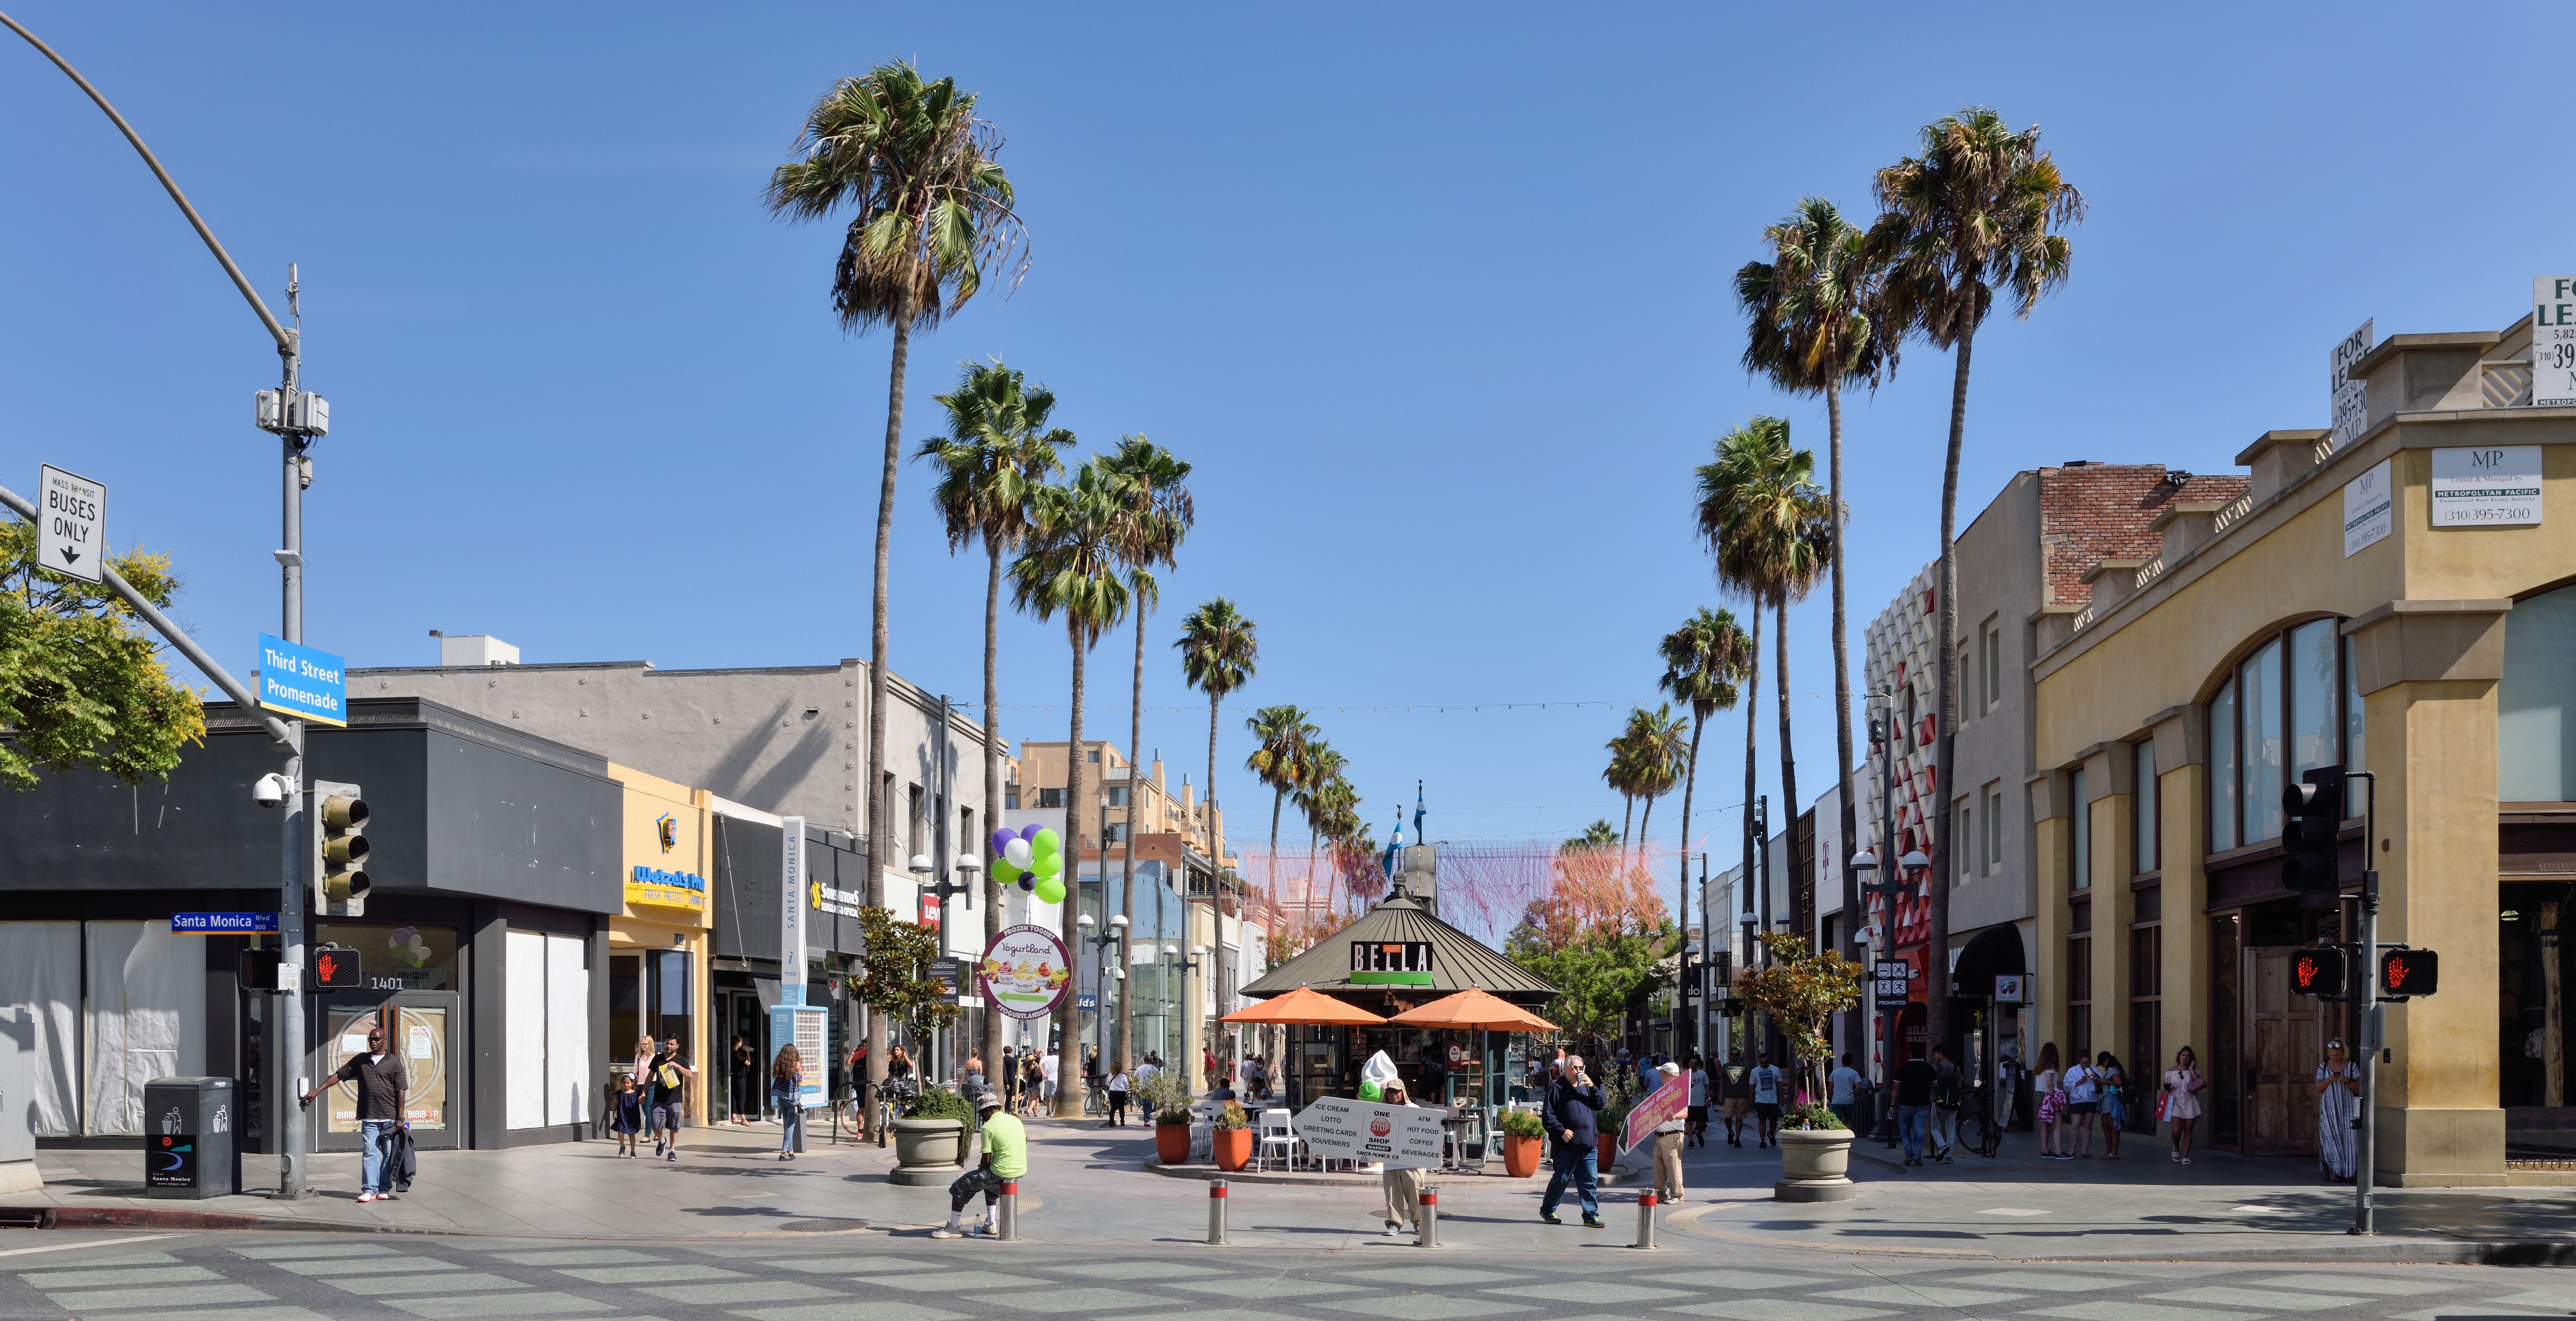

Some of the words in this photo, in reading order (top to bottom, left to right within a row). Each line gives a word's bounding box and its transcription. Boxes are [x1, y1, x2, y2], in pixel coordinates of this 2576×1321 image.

[2554, 329, 2576, 340] 5,82
[2338, 330, 2363, 366] FOR
[2338, 386, 2367, 429] 395-730
[2345, 417, 2361, 444] MP
[2471, 450, 2503, 470] MP
[53, 477, 69, 490] MASS
[71, 483, 95, 498] TRANSIT
[2360, 473, 2373, 494] MP
[2438, 489, 2501, 497] METROPOLITAN
[50, 490, 95, 521] BUSES
[2347, 511, 2373, 529] METROPOLITAN
[2375, 503, 2389, 514] PACIFIC
[54, 517, 89, 543] ONLY
[265, 648, 296, 673] Third
[301, 660, 340, 684] Street
[268, 678, 338, 710] Promenade
[788, 836, 796, 884] MONICA
[645, 889, 661, 901] FRESH
[664, 891, 683, 903] PRETZELS
[175, 915, 206, 927] Santa
[210, 915, 252, 927] Monica
[1003, 925, 1028, 936] FROZEN
[1030, 925, 1056, 940] YOGURT
[1002, 942, 1051, 957] Yogurtland
[1354, 944, 1427, 971] BELLA
[371, 977, 404, 990] 1401
[1077, 998, 1095, 1007] ids
[1327, 1105, 1349, 1113] CREAM
[1634, 1109, 1652, 1130] STORE
[1653, 1087, 1682, 1114] CLOSING
[1640, 1097, 1655, 1115] Planet
[1656, 1084, 1674, 1101] Beauty
[1303, 1125, 1334, 1134] GREETING
[1372, 1124, 1390, 1132] STOP
[1637, 1128, 1642, 1138] UP
[1643, 1125, 1648, 1134] TO
[1648, 1110, 1663, 1131] 50%
[1311, 1137, 1350, 1147] SOUVENIERS
[1402, 1149, 1439, 1158] BEVERAGES
